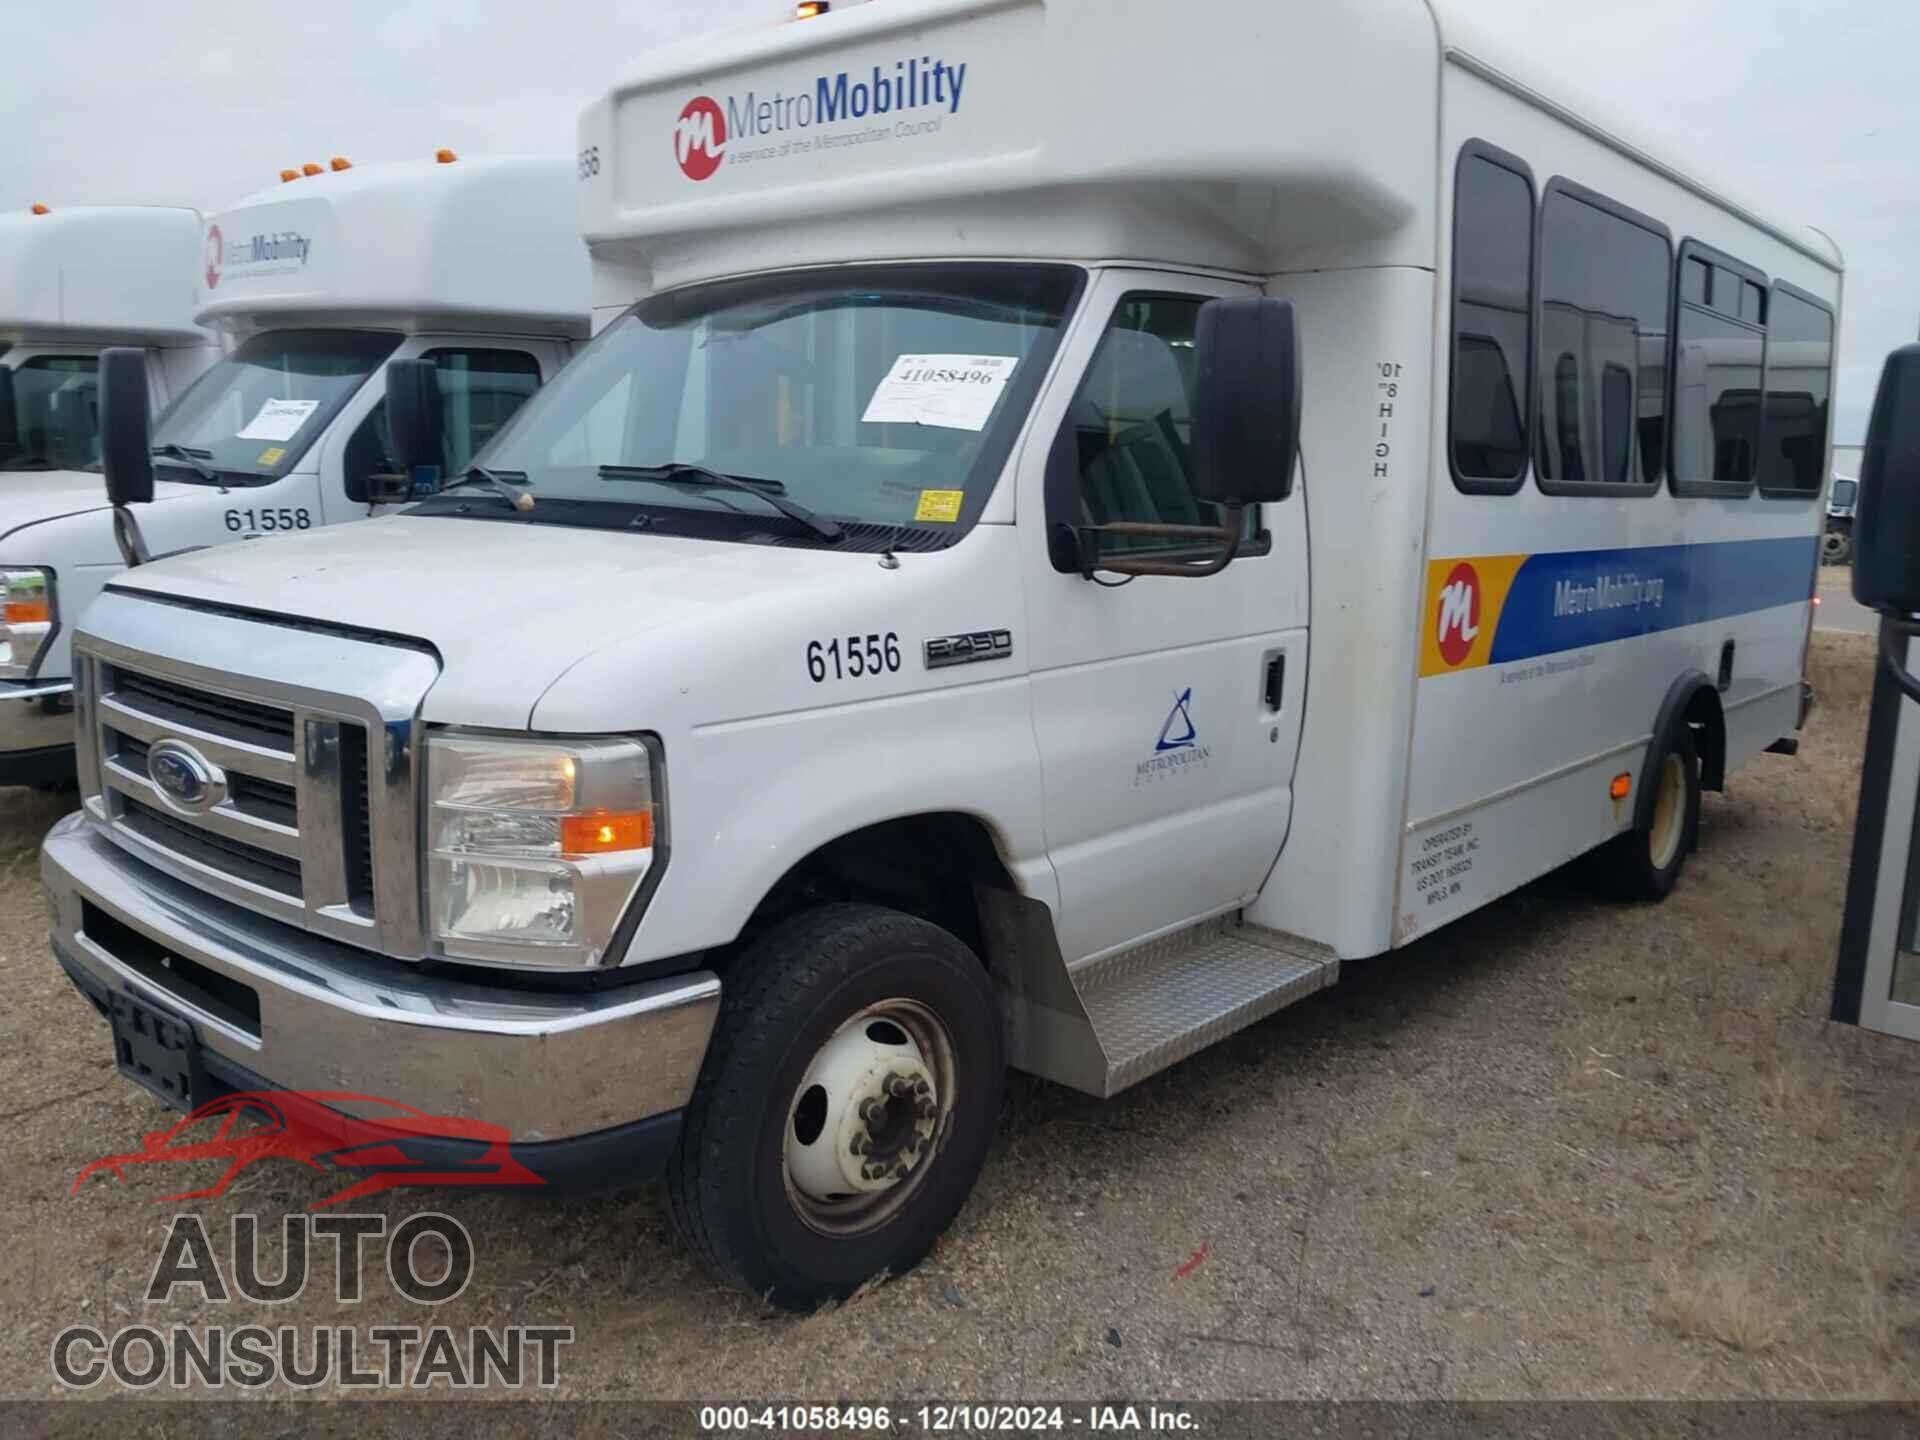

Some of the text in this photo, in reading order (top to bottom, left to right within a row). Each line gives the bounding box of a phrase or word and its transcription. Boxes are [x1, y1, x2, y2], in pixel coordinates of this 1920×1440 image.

[727, 56, 967, 141] MetroMobility
[895, 116, 942, 138] Council
[900, 369, 992, 385] 41058496
[224, 507, 312, 532] 61558
[1553, 573, 1664, 618] MetroMobility.org
[806, 631, 901, 683] 61556
